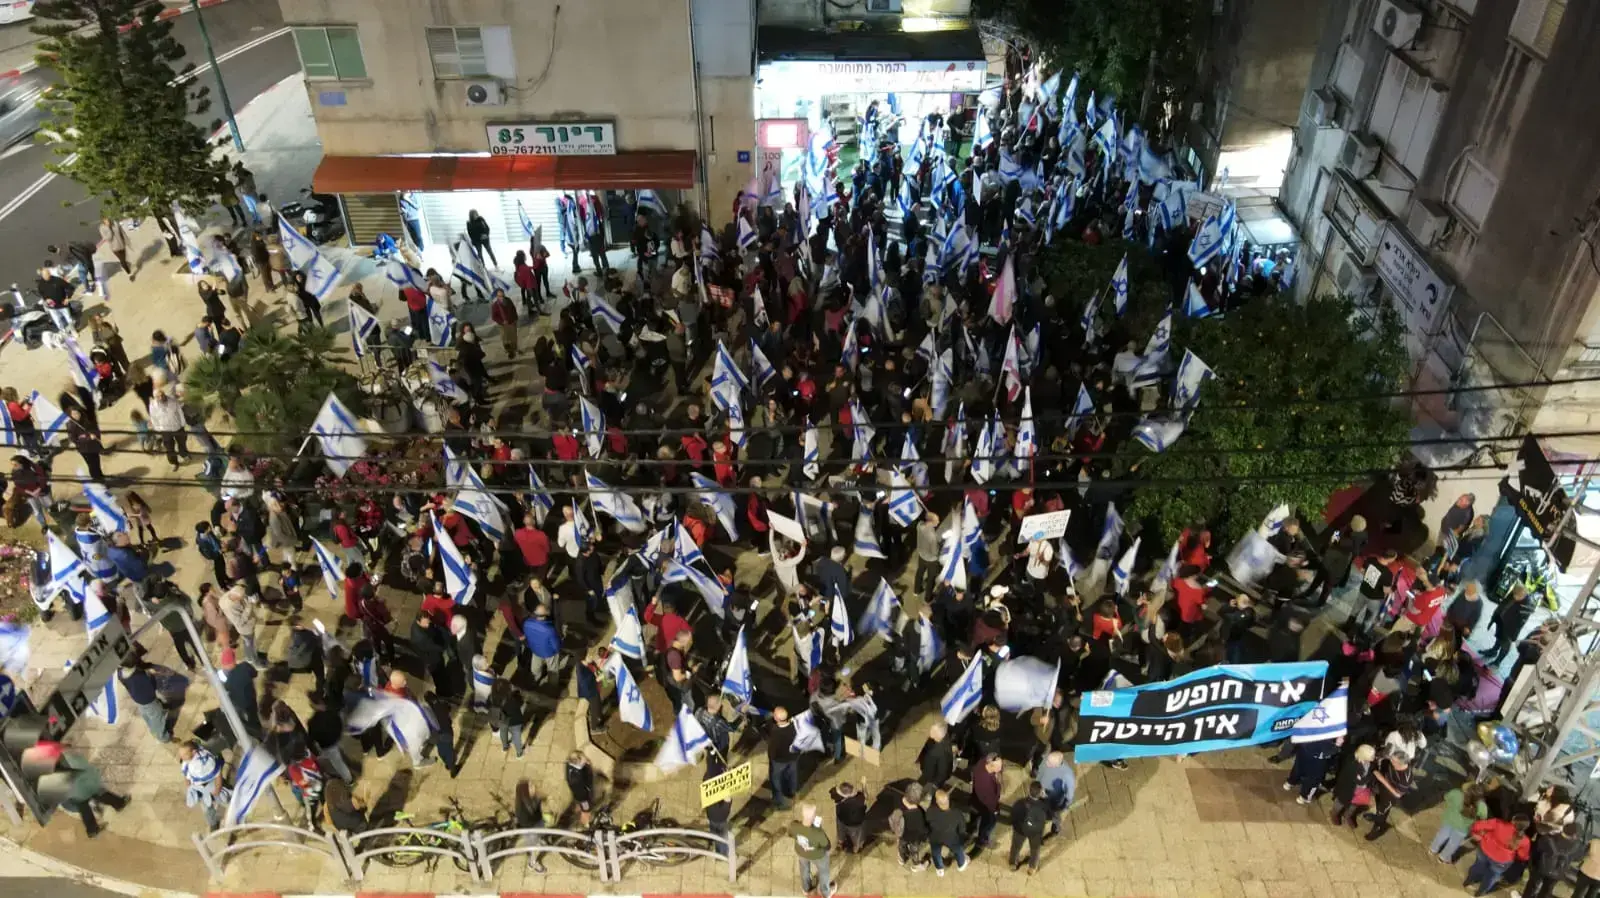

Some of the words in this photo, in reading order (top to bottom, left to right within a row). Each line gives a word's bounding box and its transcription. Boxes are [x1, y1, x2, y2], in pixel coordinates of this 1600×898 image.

[876, 63, 907, 73] רקמה
[498, 128, 525, 144] 85
[535, 126, 604, 143] דיור
[492, 145, 557, 154] 09-7672111
[1165, 679, 1243, 713] חופש
[1253, 680, 1307, 704] אין
[1089, 720, 1187, 743] הייטק
[1194, 713, 1240, 740] אין
[735, 764, 750, 777] לא
[702, 772, 734, 791] בשביל
